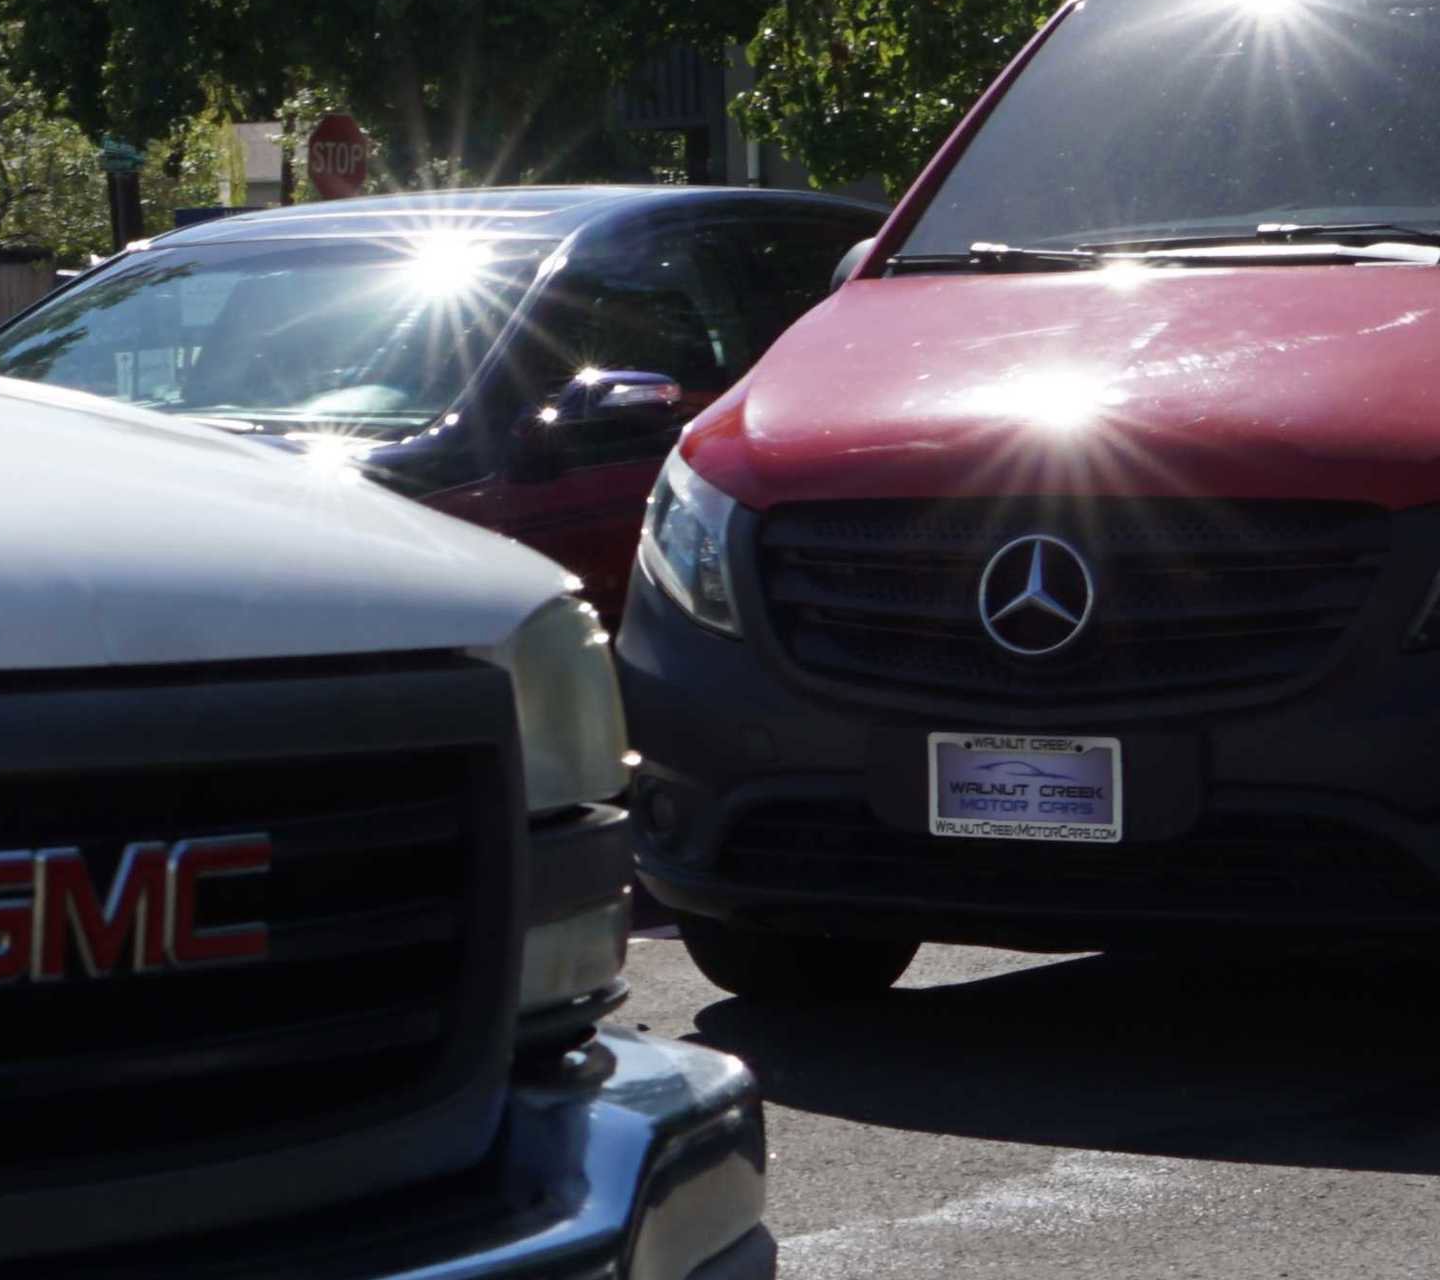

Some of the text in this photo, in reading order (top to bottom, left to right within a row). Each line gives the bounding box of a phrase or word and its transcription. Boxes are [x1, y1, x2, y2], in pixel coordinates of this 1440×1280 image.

[312, 141, 365, 177] STOP
[974, 737, 1074, 752] WALNUT CREEK
[949, 781, 1104, 799] WALNUT CREEK
[960, 798, 1094, 815] MOTOR CARS
